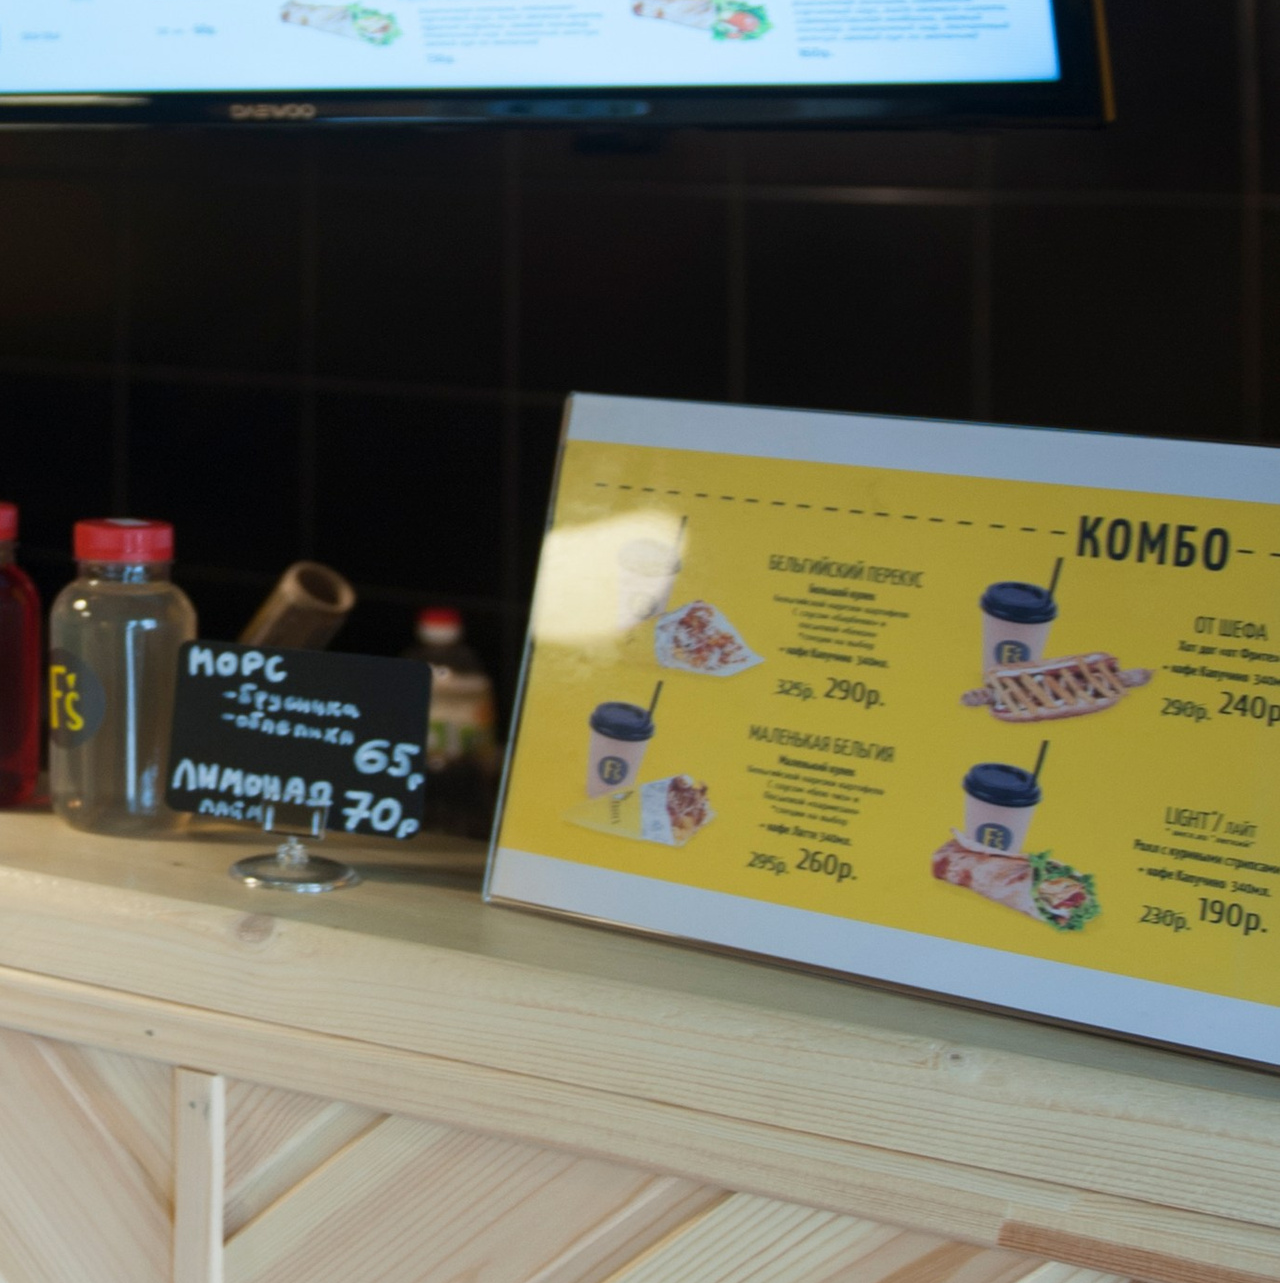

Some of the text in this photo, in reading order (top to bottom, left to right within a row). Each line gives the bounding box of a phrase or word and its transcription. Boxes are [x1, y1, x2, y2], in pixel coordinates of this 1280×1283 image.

[229, 103, 316, 119] DAEWOO
[1076, 515, 1230, 571] КОМБО
[768, 554, 865, 581] БЕЛЬГИЙСКИЙ
[1194, 616, 1269, 641] ОТ ШЕФА
[187, 645, 288, 683] МОРС
[823, 677, 886, 709] 290р.
[748, 724, 896, 763] МАЛЕНЬКАЯ БЕЛЬГИЯ
[171, 758, 334, 807] ЛИМОНАД
[795, 847, 859, 883] 260р.
[1198, 897, 1269, 937] 190р.
